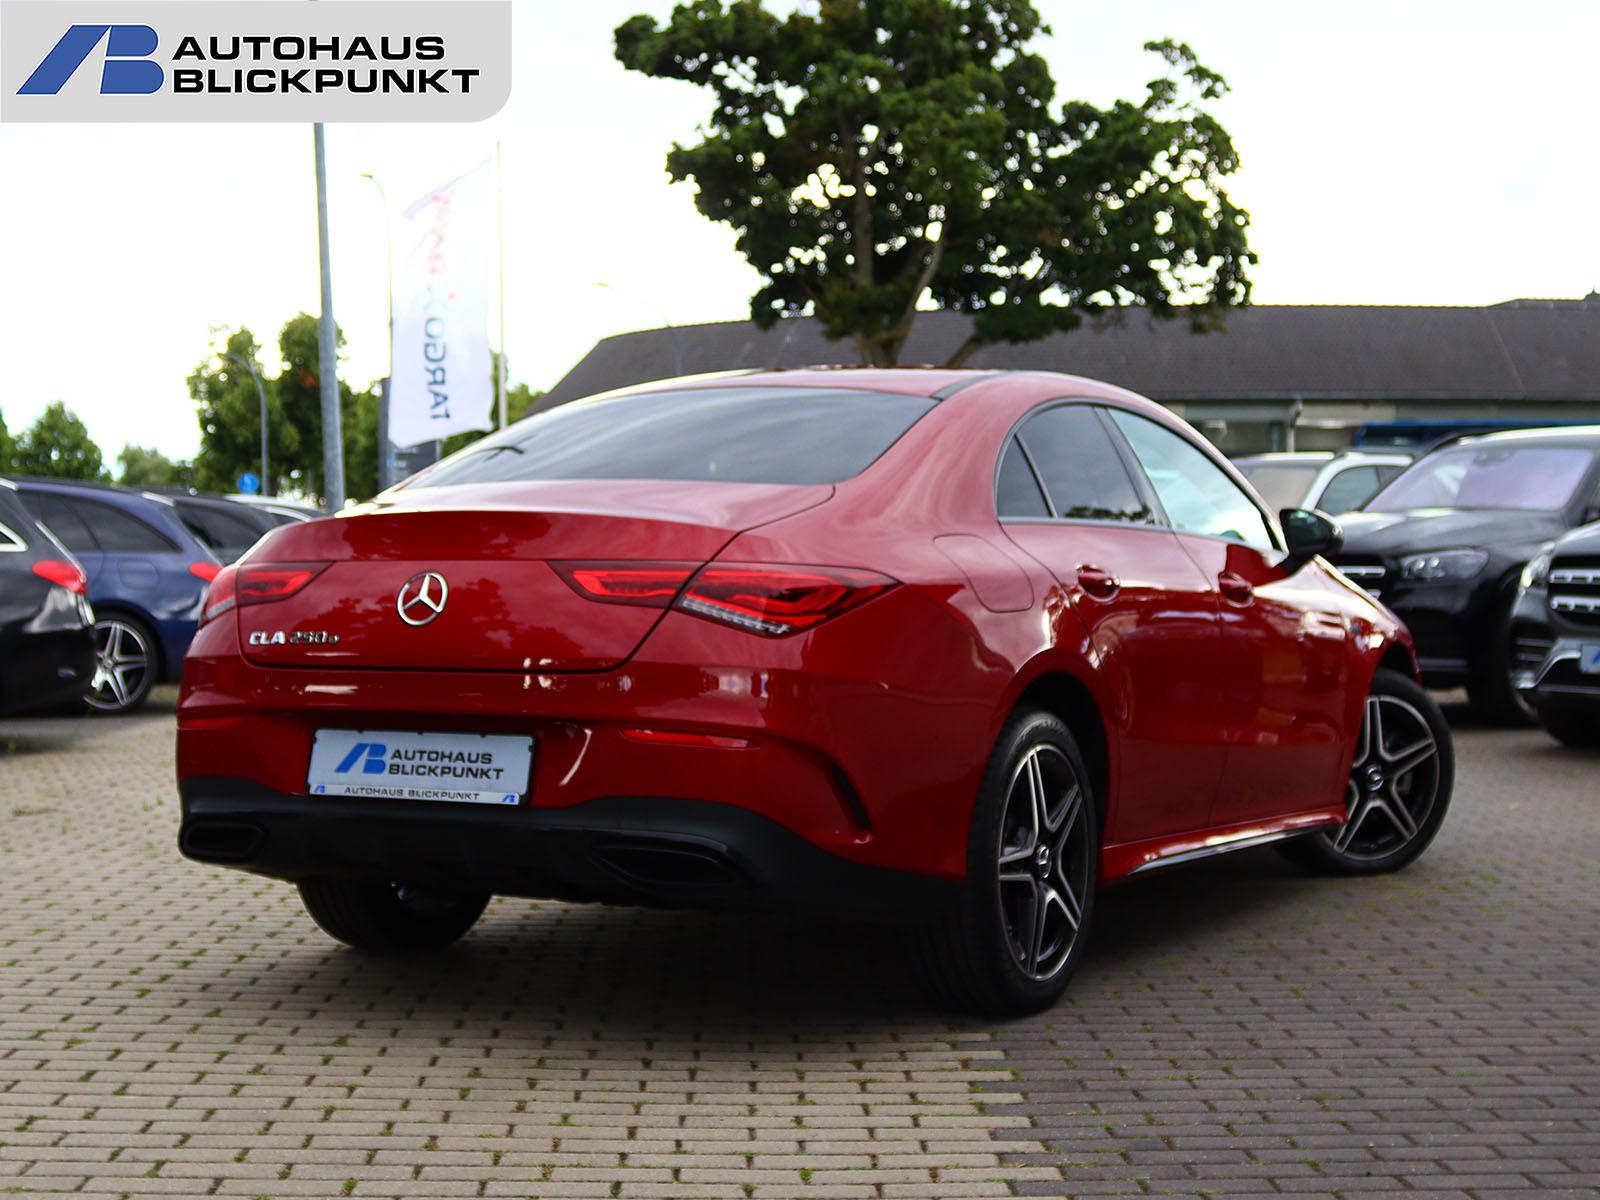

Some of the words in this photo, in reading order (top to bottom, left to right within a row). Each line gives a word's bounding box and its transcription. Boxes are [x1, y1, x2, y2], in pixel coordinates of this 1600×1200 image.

[249, 631, 286, 645] CLA
[389, 749, 493, 765] AUTOHAUS
[388, 764, 504, 780] BLICKPUNKT
[343, 787, 404, 797] AUTOHAUS
[408, 790, 480, 801] BLICKPUNKT
